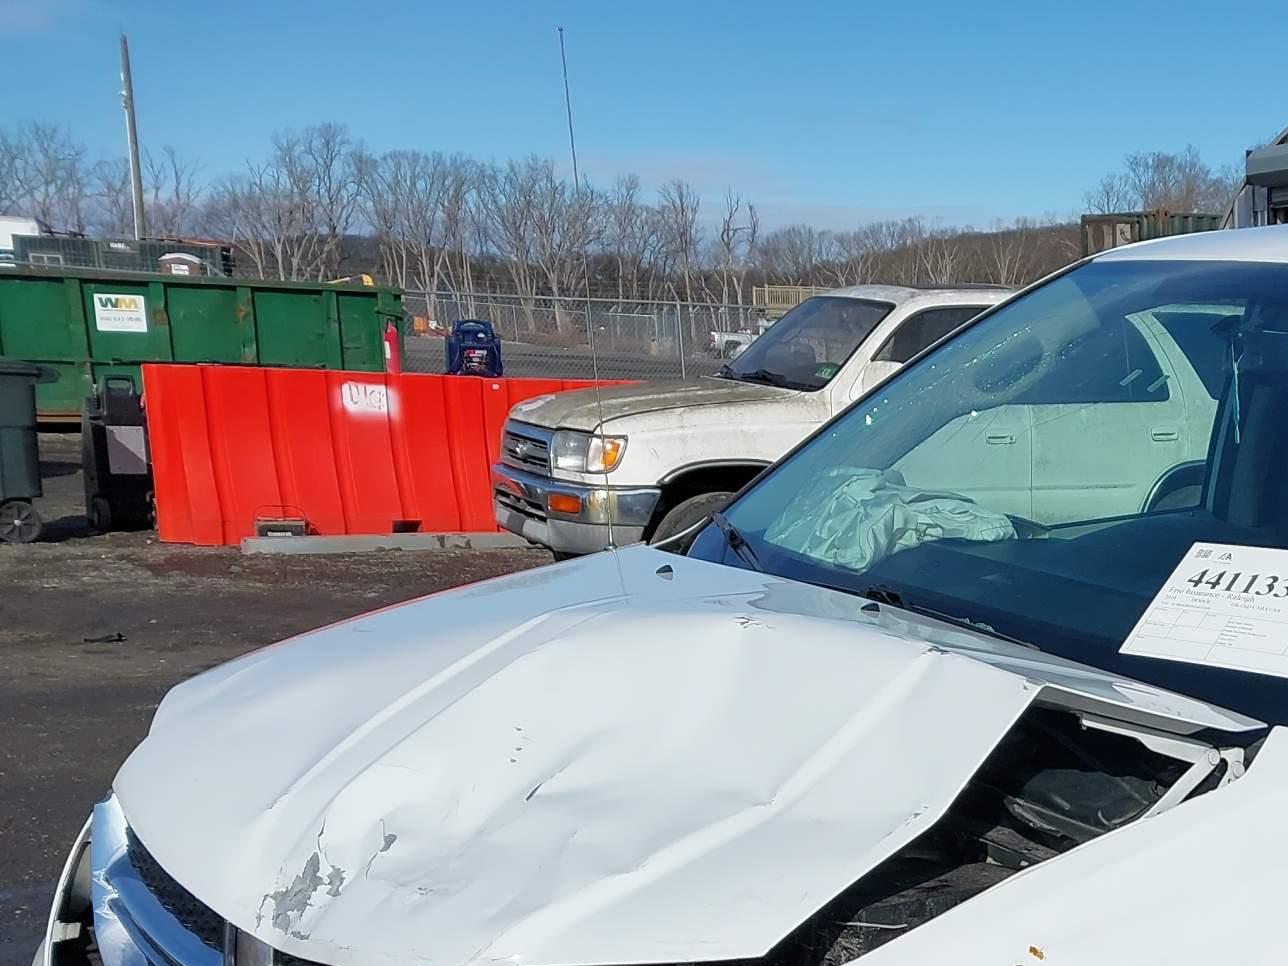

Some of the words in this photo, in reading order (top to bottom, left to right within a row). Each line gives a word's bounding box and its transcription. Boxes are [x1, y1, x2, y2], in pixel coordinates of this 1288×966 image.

[98, 296, 139, 309] WM
[1185, 588, 1221, 599] Insurance
[1226, 593, 1256, 603] Raleigh
